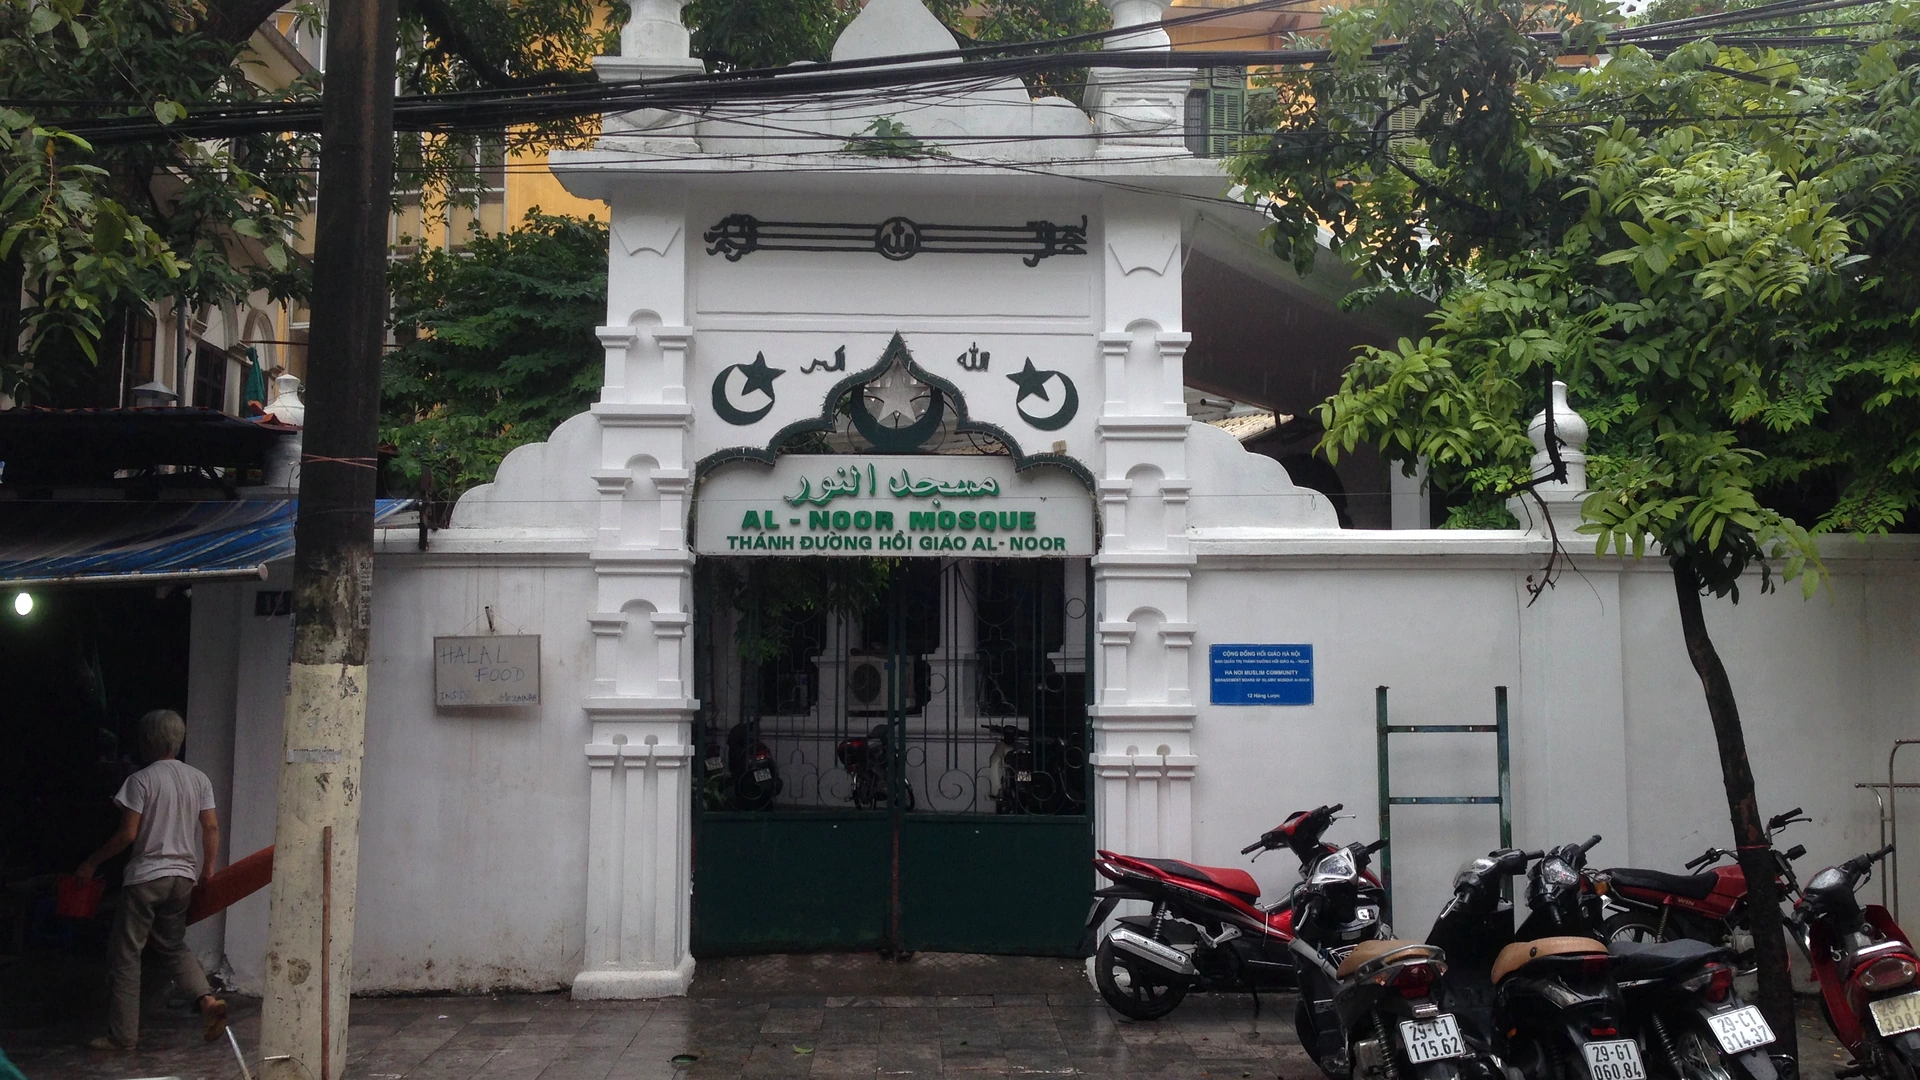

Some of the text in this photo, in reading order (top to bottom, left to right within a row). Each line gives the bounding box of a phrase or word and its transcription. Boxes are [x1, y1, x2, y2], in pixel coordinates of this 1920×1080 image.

[957, 341, 990, 372] الله
[783, 463, 1000, 509] مسجد النور
[741, 510, 780, 530] AL
[809, 510, 894, 531] NOOR
[909, 510, 1036, 532] MOSQUE
[727, 532, 794, 550] THÁNH
[800, 531, 872, 550] ĐƯỜNG
[879, 530, 912, 550] HỒI
[919, 533, 967, 551] GIÁO
[1010, 537, 1066, 551] NOOR
[440, 645, 509, 664] HALAL
[475, 667, 524, 683] FOOD
[1677, 897, 1695, 906] WIN
[1409, 1019, 1450, 1041] 29-C1
[1723, 1025, 1768, 1051] 314.37
[1411, 1036, 1461, 1060] 115.62
[1593, 1061, 1641, 1080] 060.84
